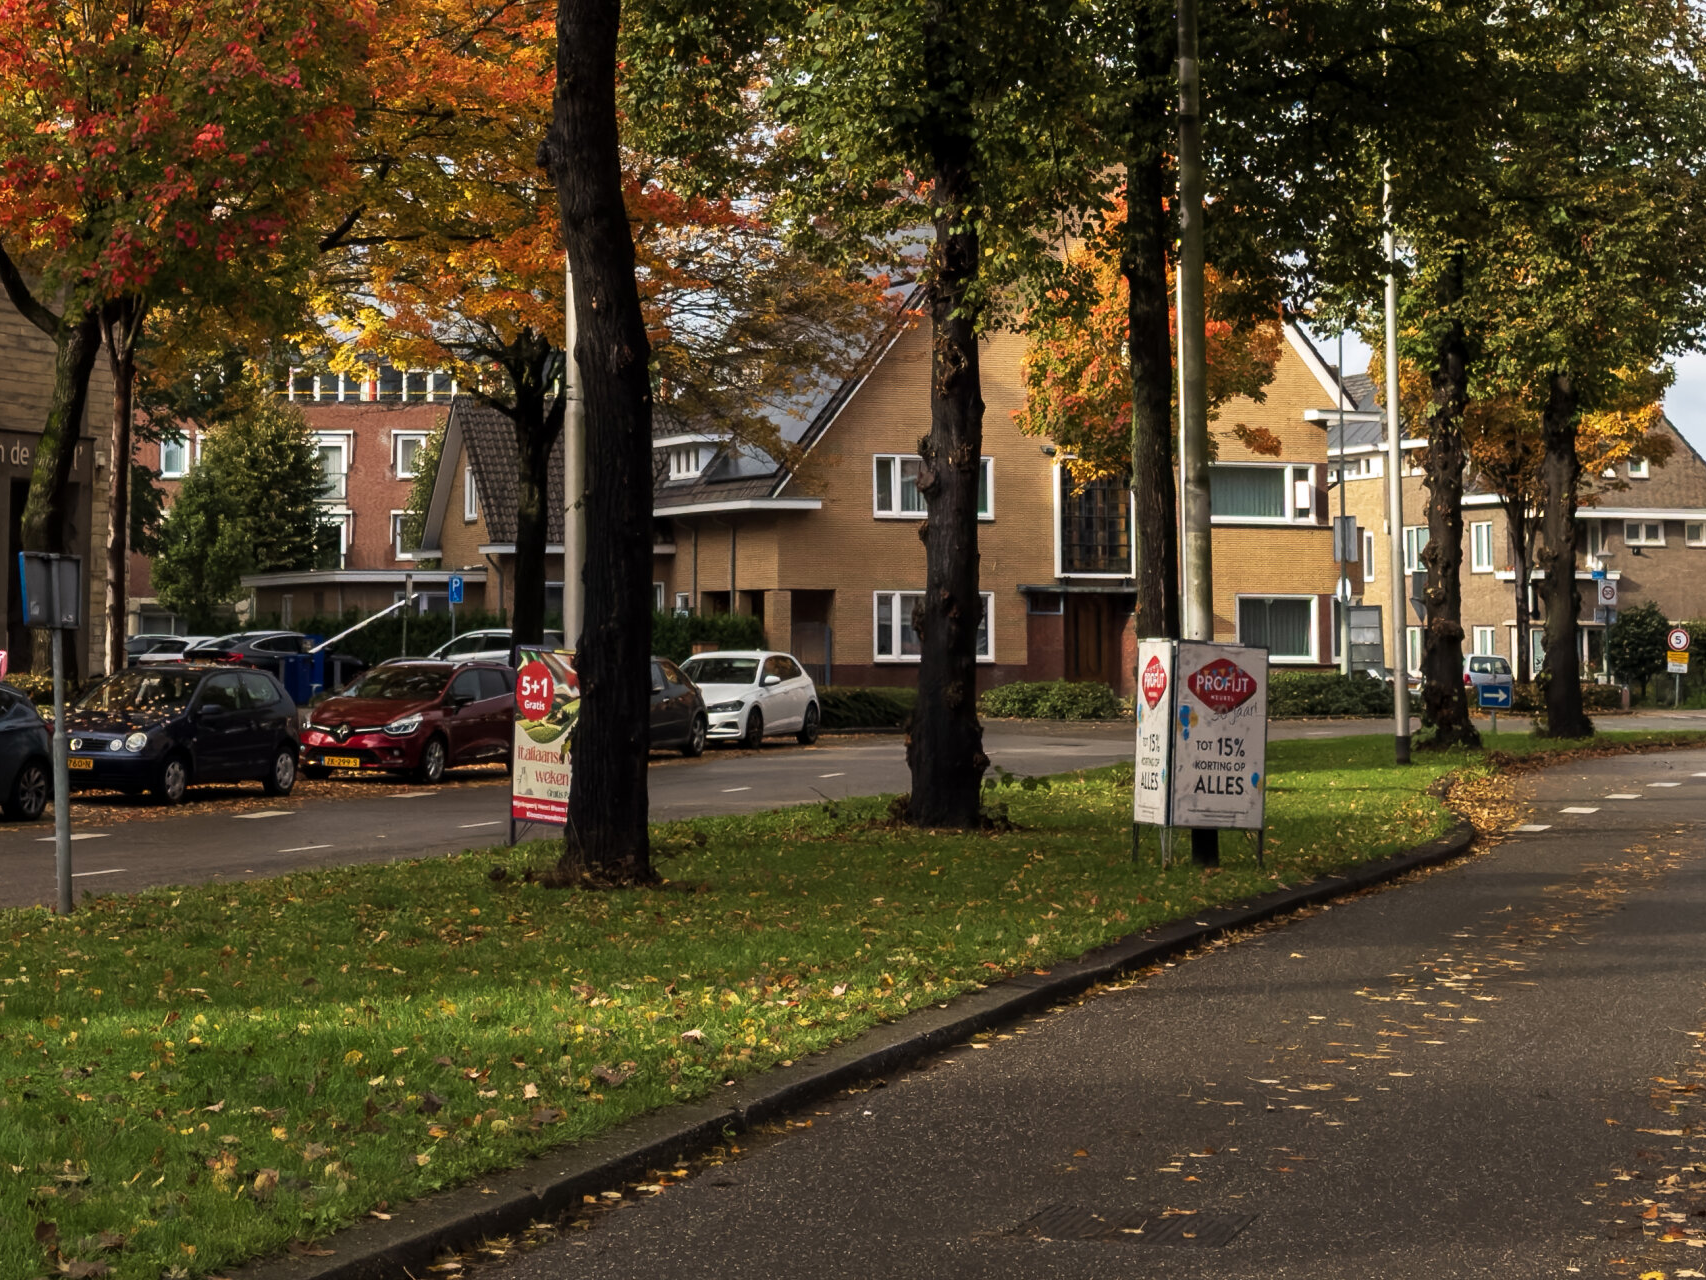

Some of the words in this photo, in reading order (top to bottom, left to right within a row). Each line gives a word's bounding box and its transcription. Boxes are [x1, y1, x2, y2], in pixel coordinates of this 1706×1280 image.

[10, 439, 30, 466] de
[452, 578, 461, 592] P
[1675, 635, 1682, 645] 5
[521, 675, 548, 698] 5+1
[1196, 674, 1249, 692] PROFIJT
[524, 700, 545, 711] Gratis
[1149, 733, 1160, 753] 15%
[1196, 740, 1213, 751] TOT
[1217, 737, 1246, 757] 15%
[1194, 760, 1232, 771] KORTING
[1233, 761, 1246, 772] OP
[535, 770, 569, 786] weken
[1140, 771, 1159, 791] ALLES
[1193, 774, 1244, 795] ALLES
